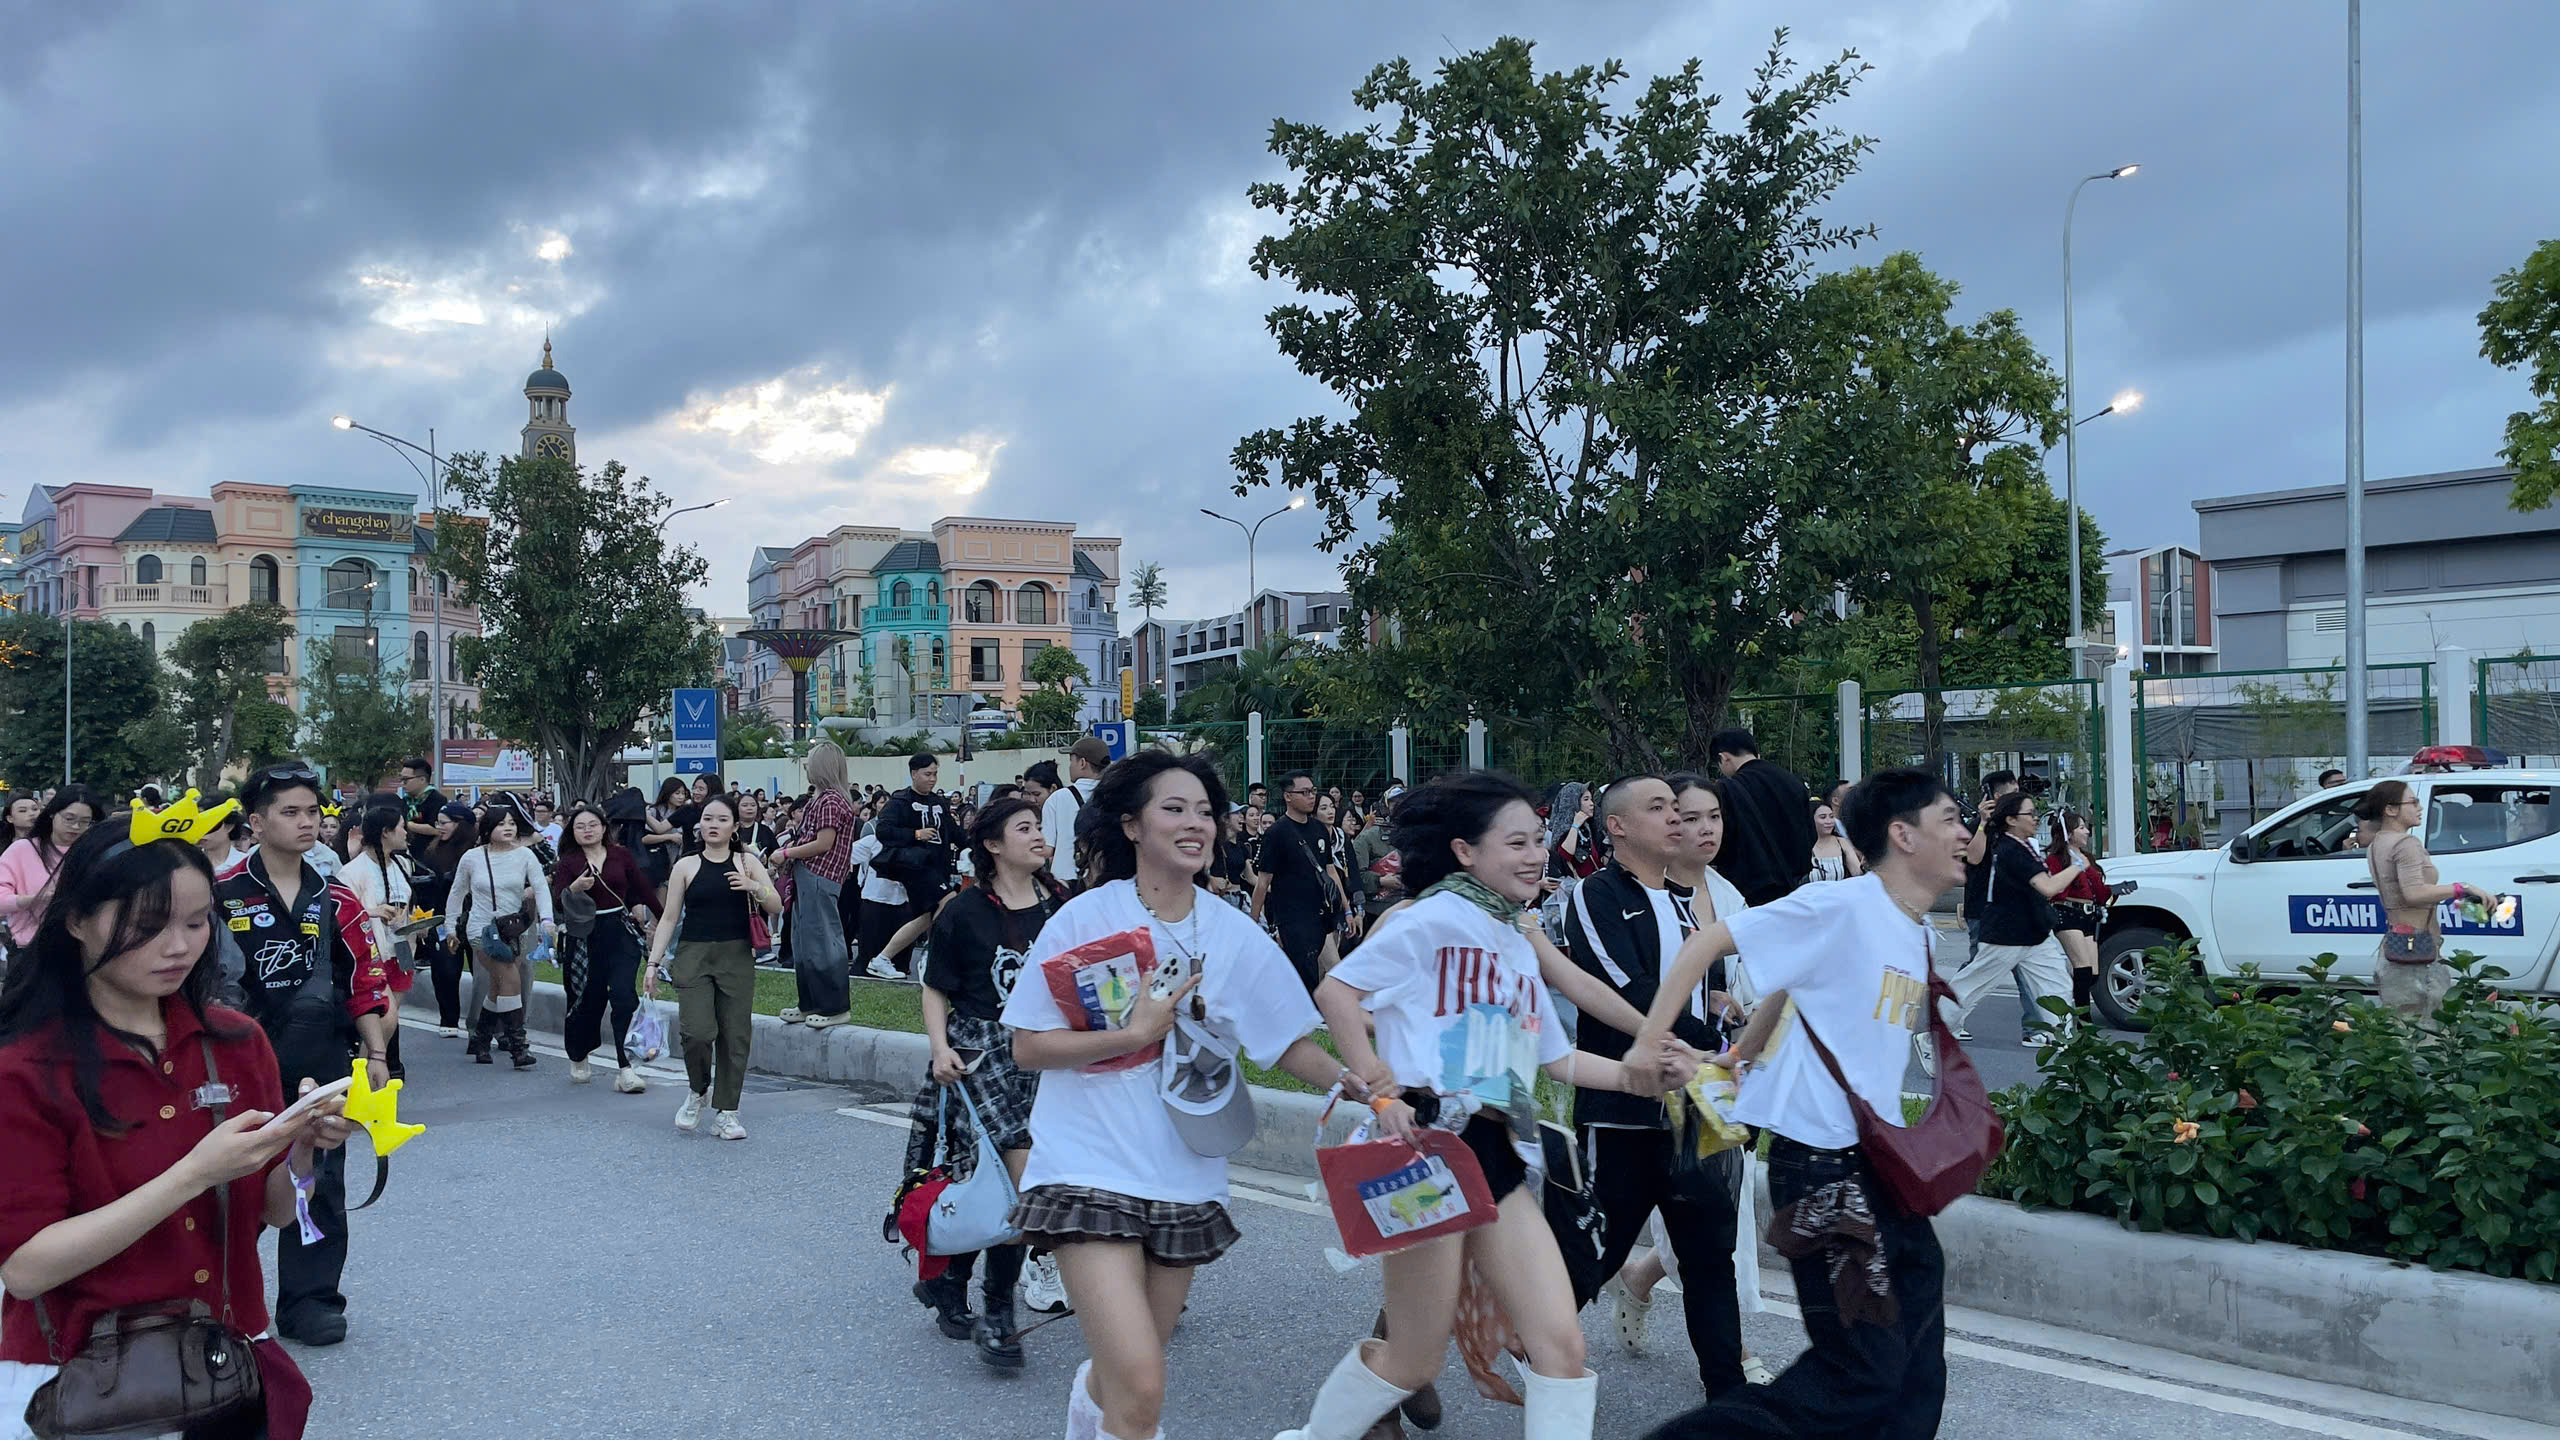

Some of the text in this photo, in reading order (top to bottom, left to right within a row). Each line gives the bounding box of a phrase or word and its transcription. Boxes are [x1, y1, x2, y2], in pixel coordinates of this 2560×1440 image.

[322, 511, 391, 532] changchay
[1102, 729, 1119, 746] P
[161, 819, 194, 833] GD
[231, 903, 269, 917] SIEMENS
[2306, 898, 2377, 928] CẢNH
[265, 980, 291, 989] KING
